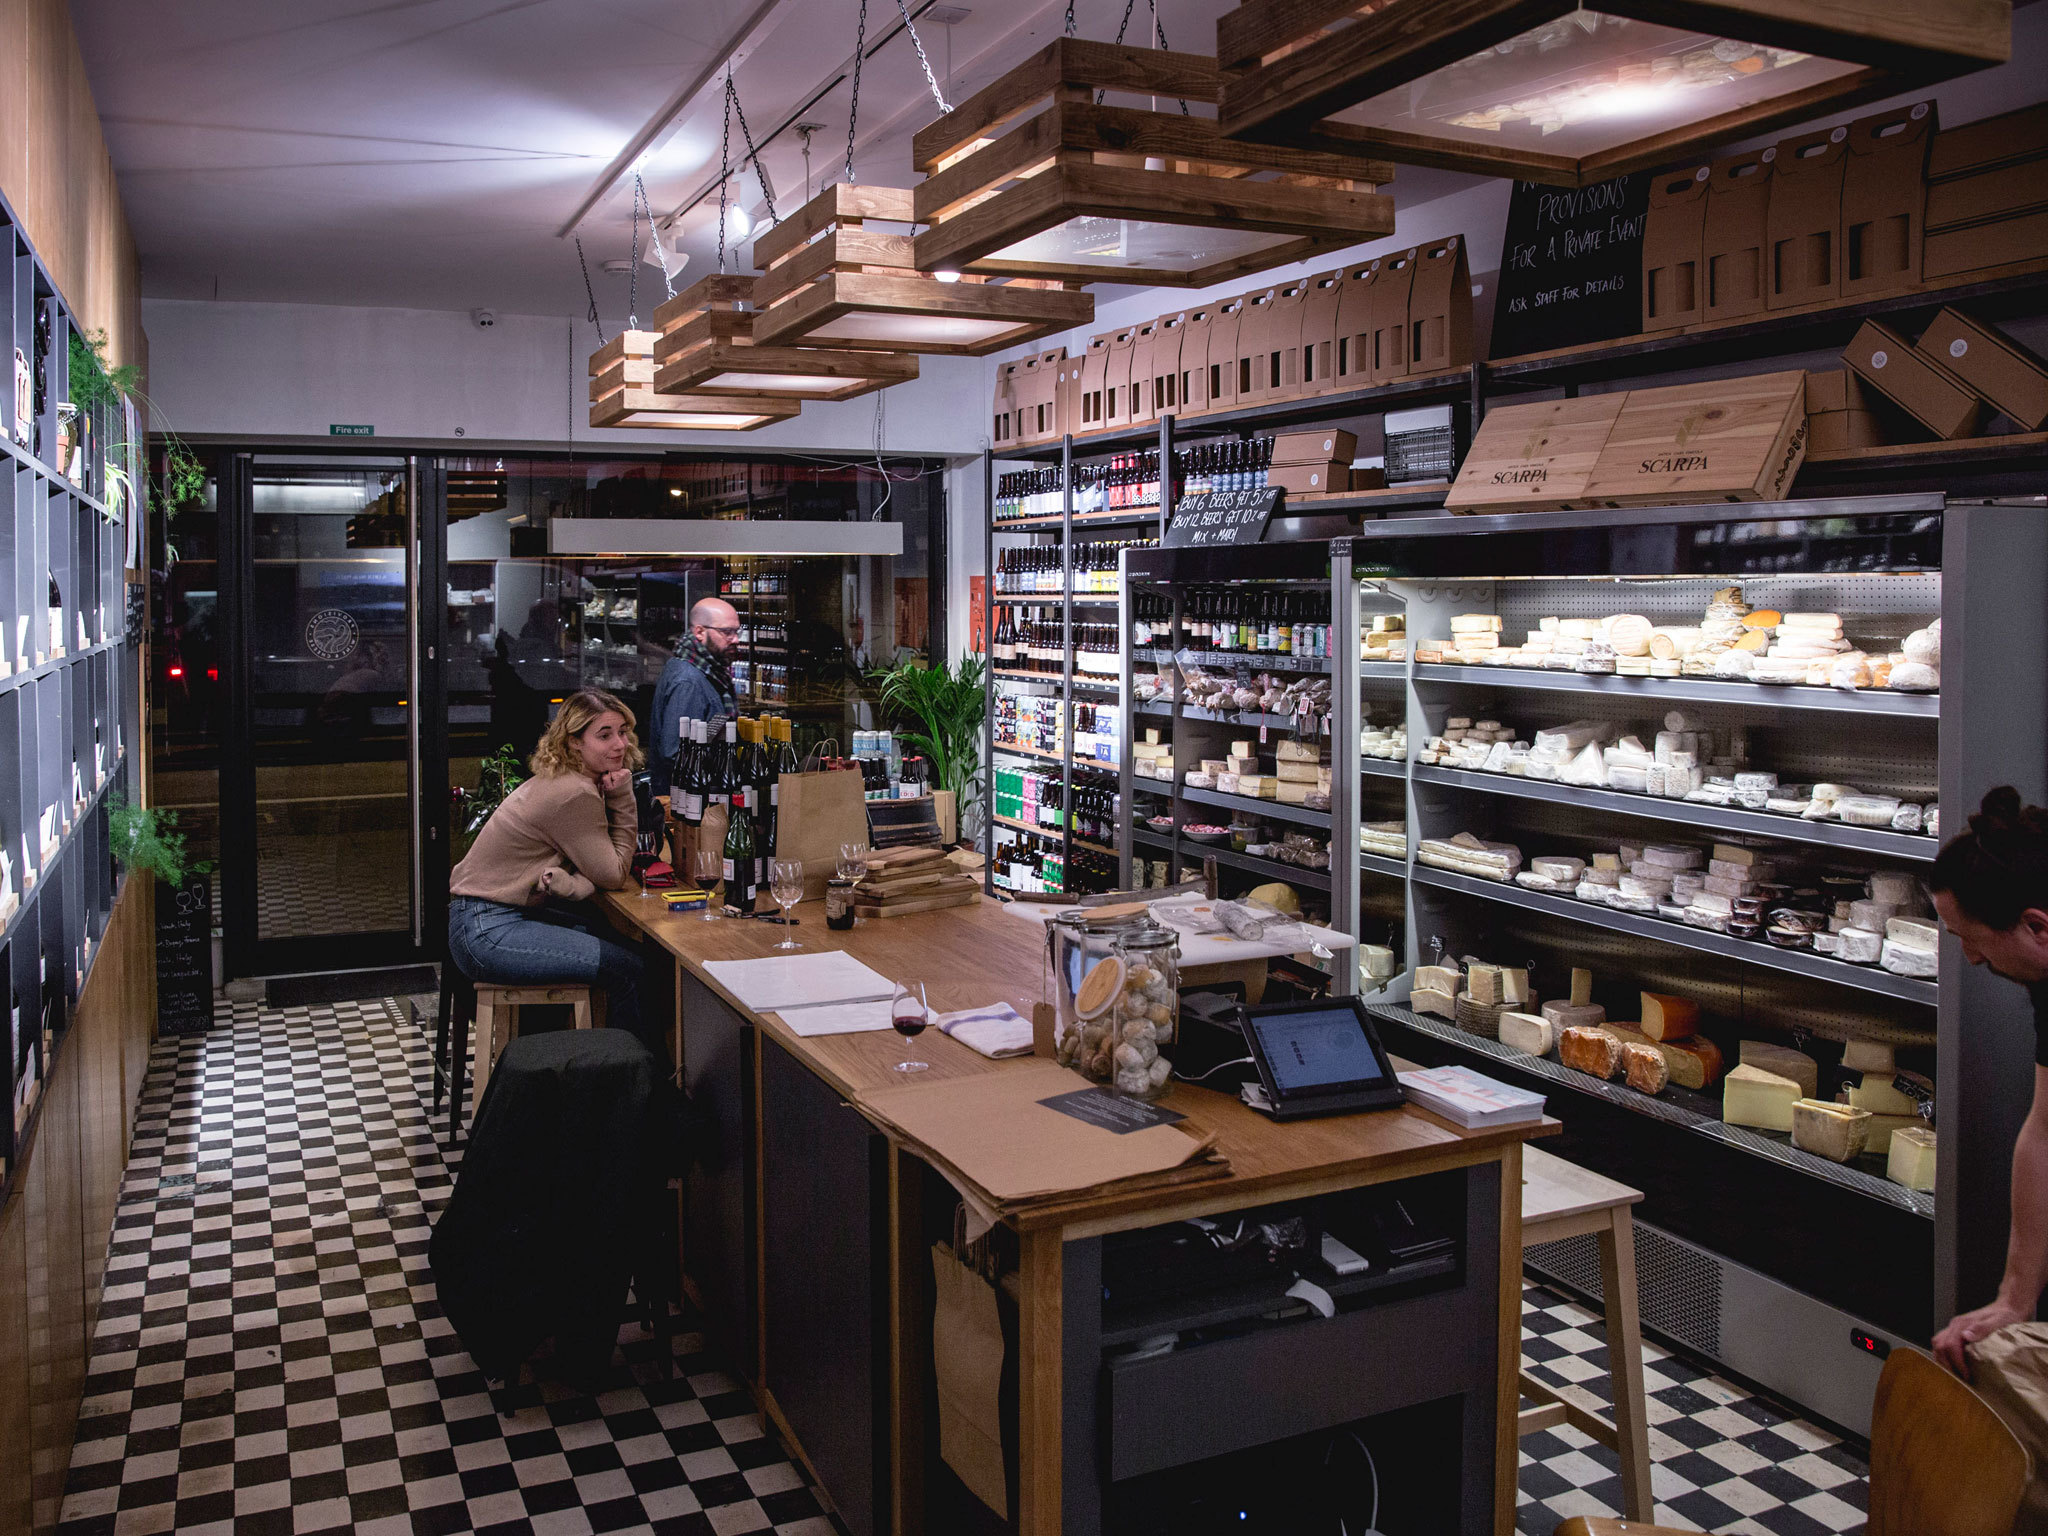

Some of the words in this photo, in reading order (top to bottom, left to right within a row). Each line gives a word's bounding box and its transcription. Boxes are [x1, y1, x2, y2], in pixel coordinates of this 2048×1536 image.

[1537, 175, 1628, 231] PROVISIONS
[1509, 243, 1537, 271] FOR
[1547, 236, 1556, 261] A
[1564, 229, 1604, 259] PRIVATE
[1608, 213, 1648, 244] EVENT
[1508, 297, 1527, 313] ASK
[1534, 289, 1560, 307] STAFF
[1562, 286, 1580, 300] FOR
[1585, 276, 1625, 295] DETAILS
[335, 426, 352, 434] Fire
[353, 426, 369, 434] exit
[1637, 455, 1708, 474] SCARPA
[1491, 469, 1548, 485] SCARPA
[1180, 495, 1197, 511] BUY
[1197, 494, 1208, 511] 6
[1209, 491, 1236, 510] BEERS
[1236, 490, 1251, 509] GET
[1172, 515, 1191, 529] BUY
[1200, 511, 1224, 526] BEERS
[1225, 509, 1243, 526] GET
[1192, 530, 1209, 543] MIX
[1216, 527, 1239, 542] MATCH
